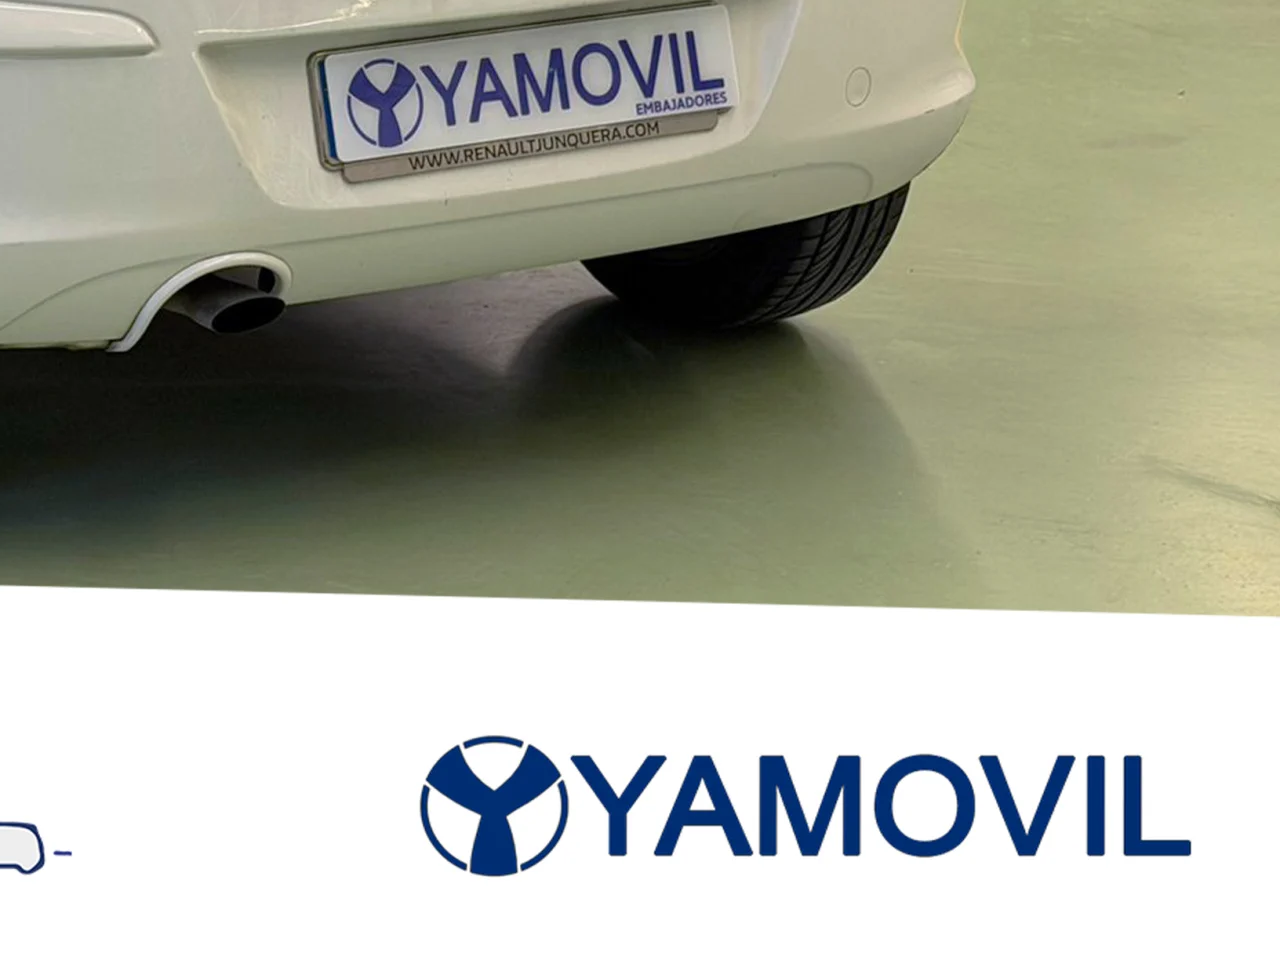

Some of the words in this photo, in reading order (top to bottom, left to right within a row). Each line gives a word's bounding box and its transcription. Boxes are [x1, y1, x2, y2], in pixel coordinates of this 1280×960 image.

[420, 30, 725, 126] YAMOVIL
[635, 91, 728, 116] EMBAJADORES
[408, 120, 660, 170] WWW.RENAULTJUNQUERA.COM
